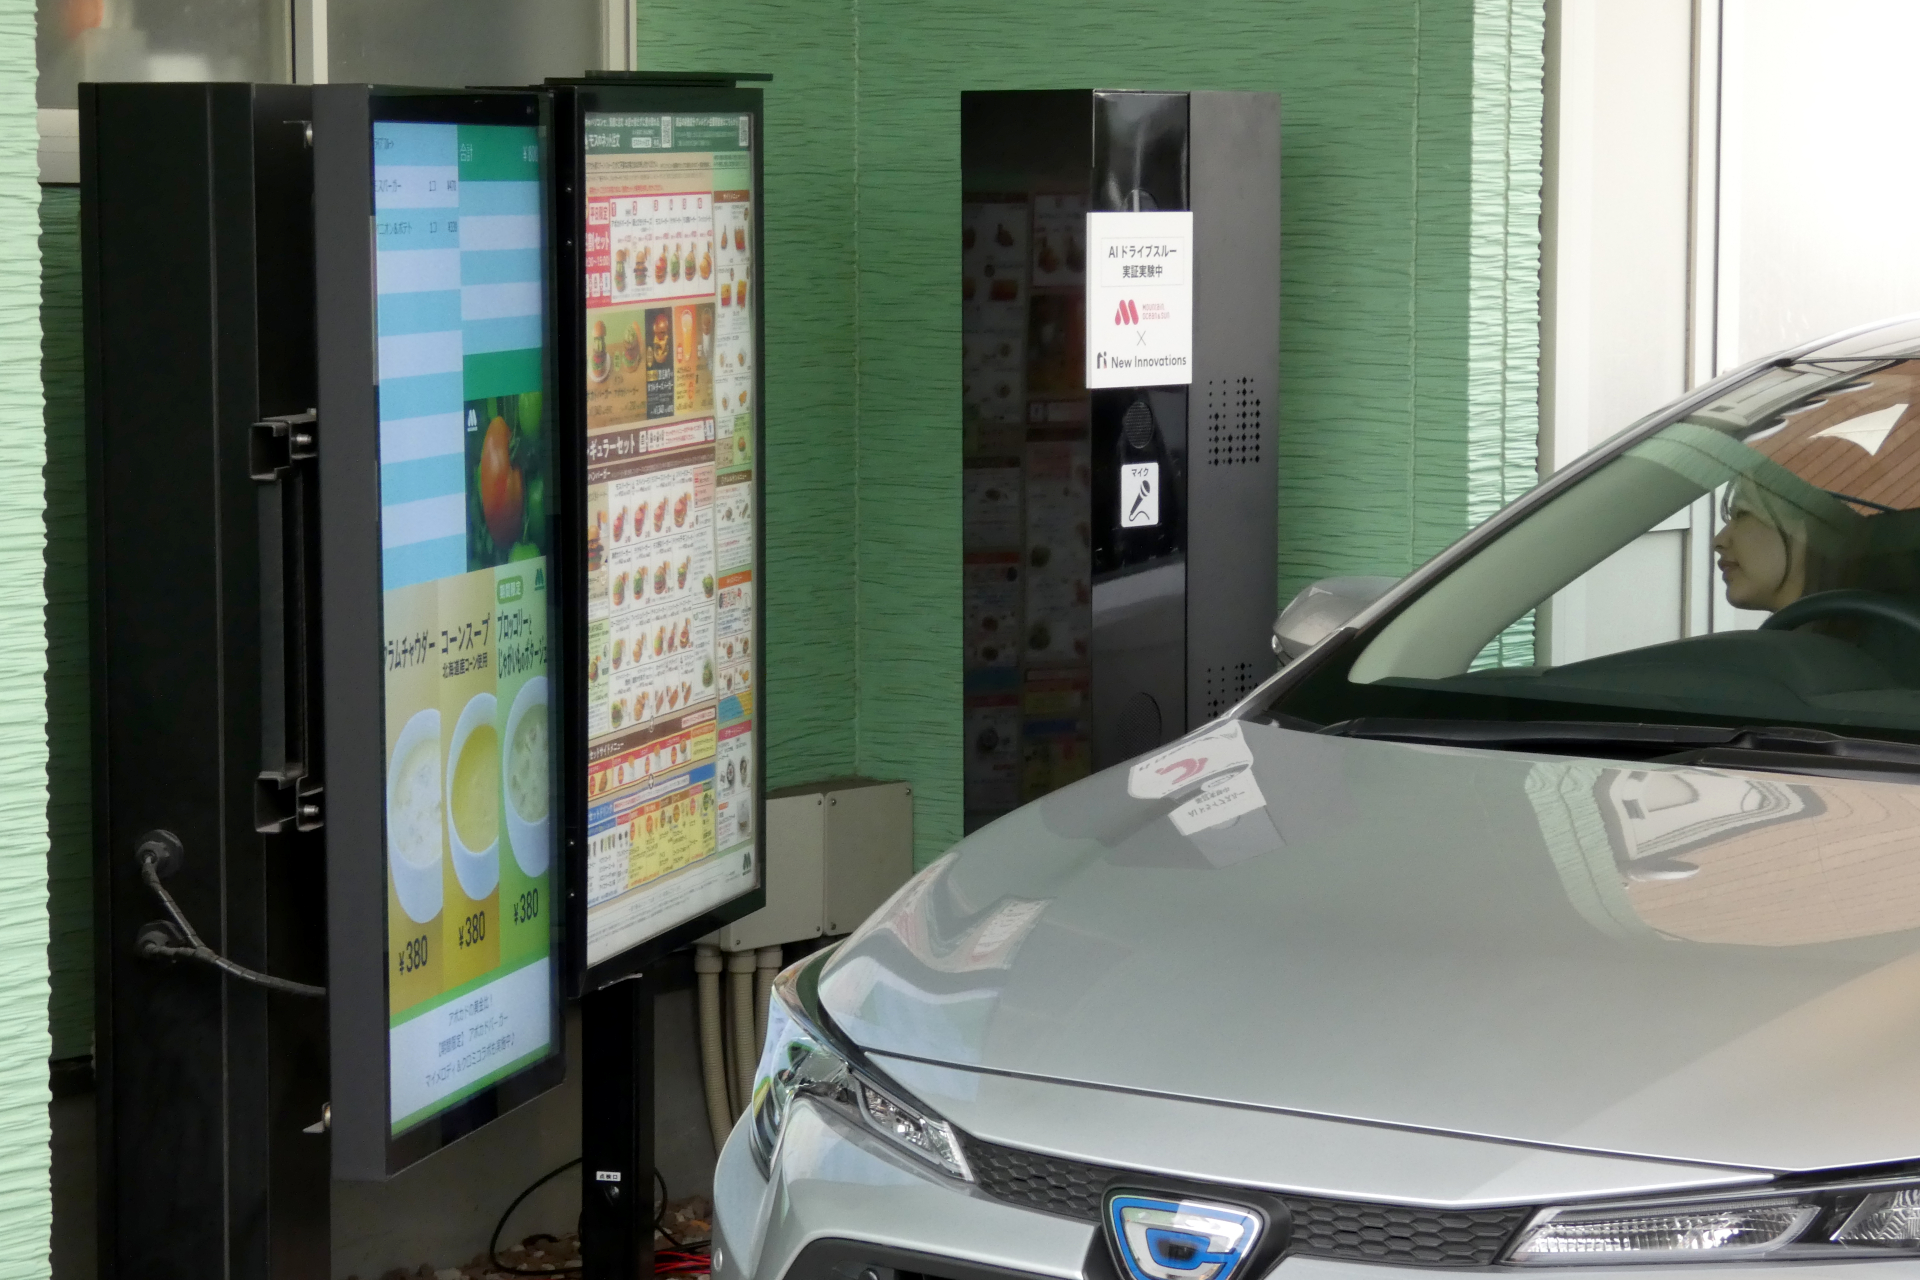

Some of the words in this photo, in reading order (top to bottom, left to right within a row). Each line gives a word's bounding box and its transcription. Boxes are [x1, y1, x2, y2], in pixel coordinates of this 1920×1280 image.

[460, 143, 473, 162] 合計
[377, 221, 412, 235] ニオン&ポテト
[1122, 264, 1164, 279] 実証実験中
[1111, 356, 1132, 369] New
[1134, 354, 1187, 368] Innovations
[587, 433, 636, 461] ギュラーセット
[1131, 467, 1150, 477] マイク
[441, 612, 491, 655] コーンスープ
[497, 608, 532, 643] ブロッコリーと
[385, 628, 436, 672] ラムチャウダー
[442, 652, 488, 680] 北海道産コーン使用
[513, 888, 539, 926] ¥380
[458, 910, 486, 950] ¥380
[398, 934, 428, 976] ¥380
